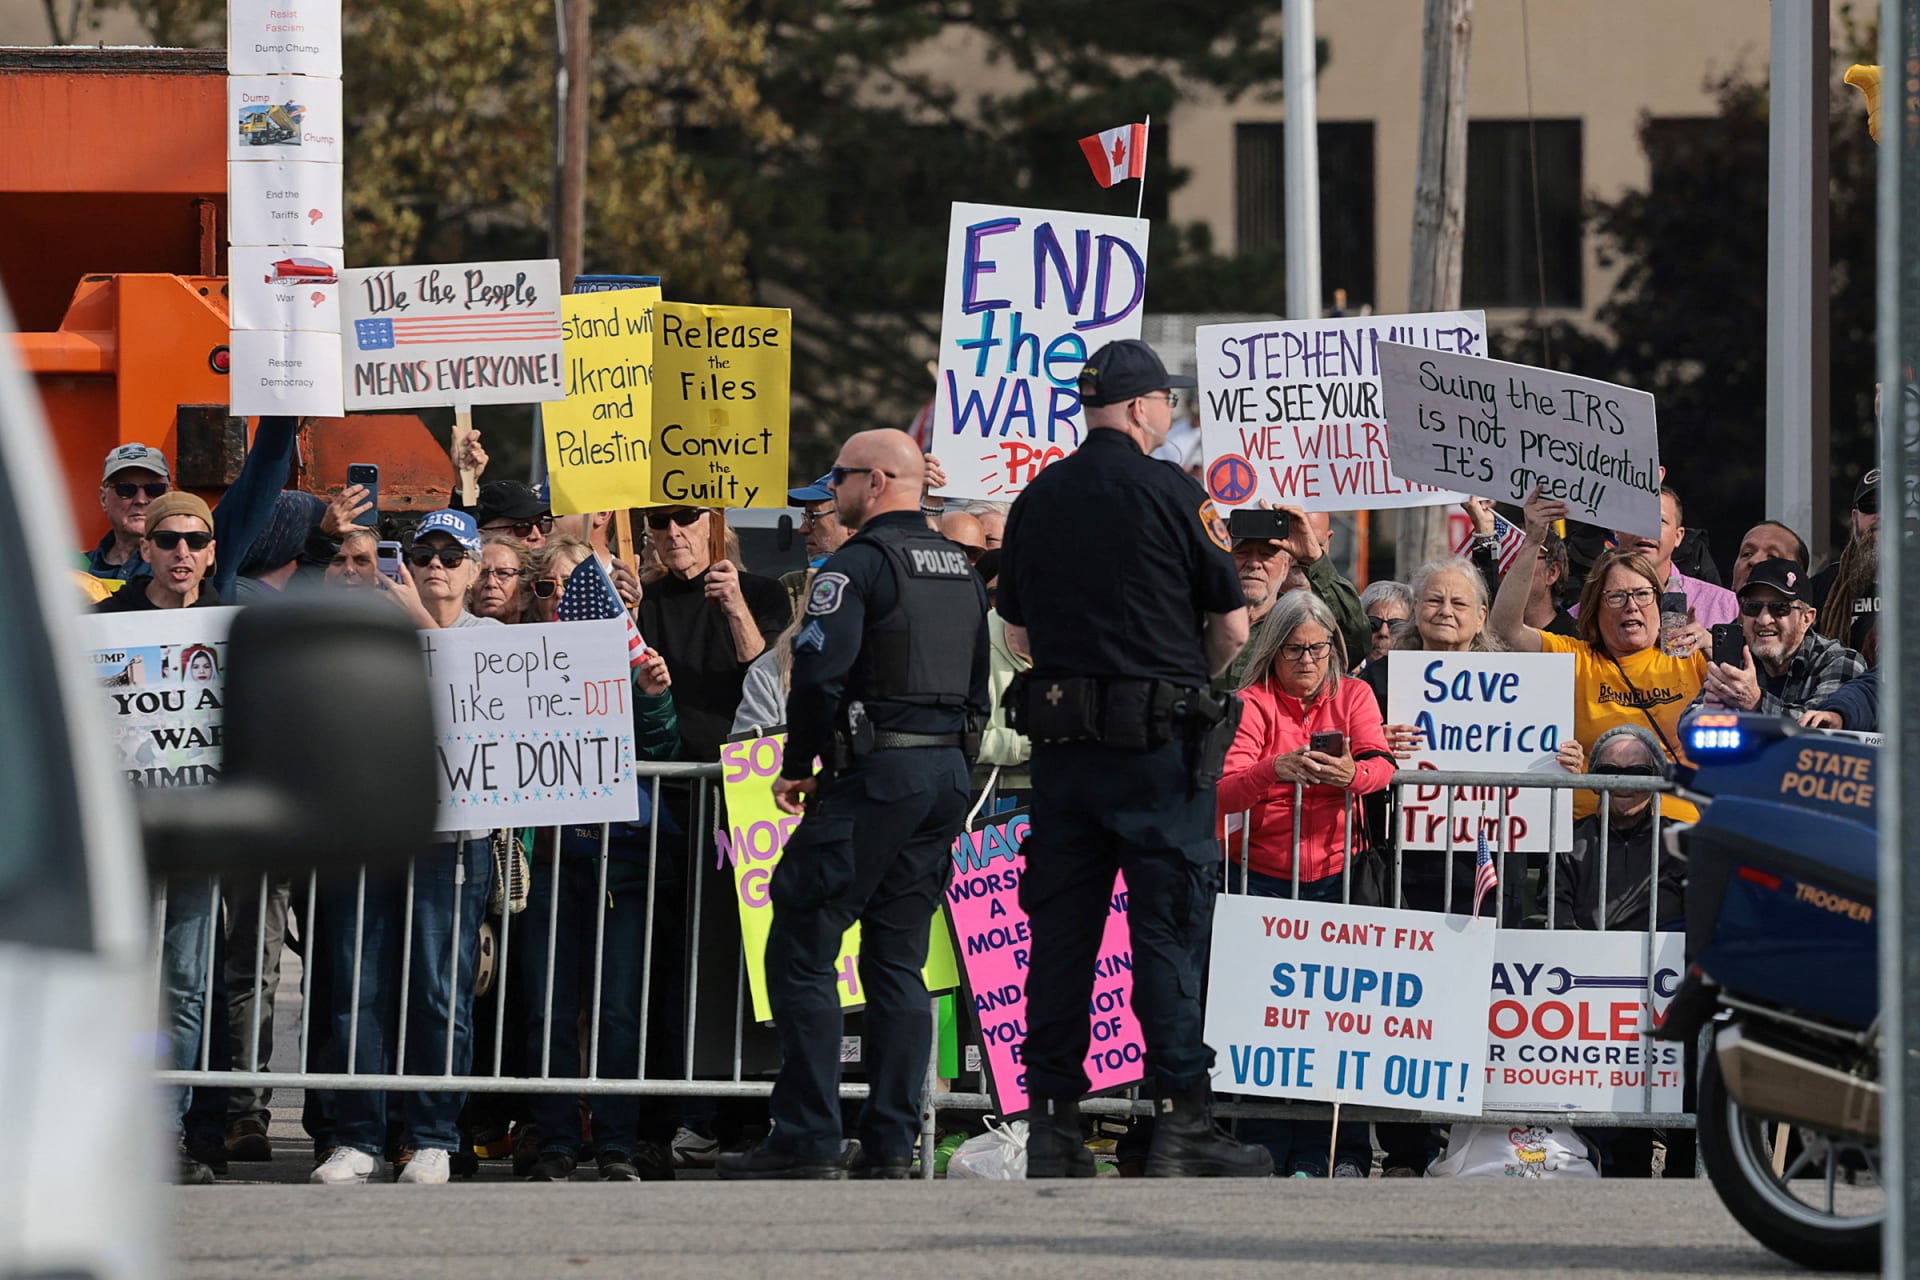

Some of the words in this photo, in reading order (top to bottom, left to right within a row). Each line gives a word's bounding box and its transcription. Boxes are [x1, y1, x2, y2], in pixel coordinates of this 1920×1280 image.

[265, 23, 305, 33] Fascism
[269, 9, 298, 19] Resist
[255, 44, 284, 55] Dump
[286, 44, 320, 55] Chump
[242, 93, 270, 104] Dump
[303, 132, 335, 145] Chump
[266, 190, 282, 200] End
[284, 190, 299, 200] the
[270, 210, 299, 220] Tariffs
[961, 217, 1146, 331] END
[275, 293, 295, 303] War
[361, 270, 410, 315] We
[414, 269, 456, 305] the
[464, 269, 538, 311] People
[562, 307, 620, 341] stand
[625, 308, 654, 335] wit
[663, 313, 779, 349] Release
[268, 358, 303, 368] Restore
[707, 355, 731, 369] the
[955, 309, 1089, 388] the
[1218, 328, 1363, 380] STEPHEN
[261, 377, 314, 389] Democracy
[354, 360, 433, 396] MEANS
[436, 353, 561, 391] EVERYONE!
[680, 371, 757, 401] Files
[592, 393, 633, 420] and
[944, 369, 1082, 447] WAR
[1207, 387, 1258, 423] WE
[1265, 383, 1317, 423] SEE
[1315, 382, 1380, 420] YOUR
[1419, 361, 1498, 419] Suing
[1506, 377, 1557, 416] the
[1561, 389, 1625, 435] IRS
[556, 430, 652, 467] Palestin
[660, 424, 773, 456] Convict
[1238, 425, 1285, 461] WE
[1293, 423, 1363, 460] WILL
[1418, 403, 1446, 433] is
[1458, 414, 1507, 449] not
[1520, 429, 1660, 498] presidential,
[708, 461, 731, 474] the
[1269, 463, 1321, 498] WE
[1329, 460, 1402, 496] WILL
[1431, 443, 1494, 482] It's
[1510, 467, 1606, 518] greed!!
[662, 469, 759, 508] Guilty
[910, 550, 969, 576] POLICE
[89, 652, 126, 664] UMP
[474, 635, 571, 691] people
[1423, 659, 1520, 704] Save
[111, 690, 186, 715] YOU
[449, 683, 505, 724] like
[1410, 710, 1560, 753] America
[437, 741, 498, 792] WE
[516, 736, 621, 789] DON'T!
[1796, 748, 1872, 782] STATE
[1780, 771, 1876, 808] POLICE
[951, 813, 1032, 875] MAG
[1402, 805, 1528, 853] Trump
[947, 866, 1024, 904] WORS
[989, 897, 1007, 919] A
[1795, 882, 1873, 925] TROOPER
[1262, 915, 1310, 941] YOU
[1320, 921, 1386, 947] CAN'T
[1394, 928, 1435, 951] FIX
[1269, 962, 1423, 1008] STUPID
[1491, 962, 1545, 996] AY
[974, 984, 1022, 1016] AND
[1092, 1016, 1122, 1042] OF
[1263, 1006, 1311, 1030] BUT
[1324, 1011, 1372, 1035] YOU
[1383, 1016, 1433, 1040] CAN
[1090, 1042, 1142, 1074] TOO
[1518, 1044, 1678, 1065] CONGRESS
[1229, 1044, 1315, 1088] VOTE
[1336, 1050, 1371, 1090] IT
[1383, 1054, 1470, 1102] OUT!
[1503, 1068, 1603, 1089] BOUGHT,
